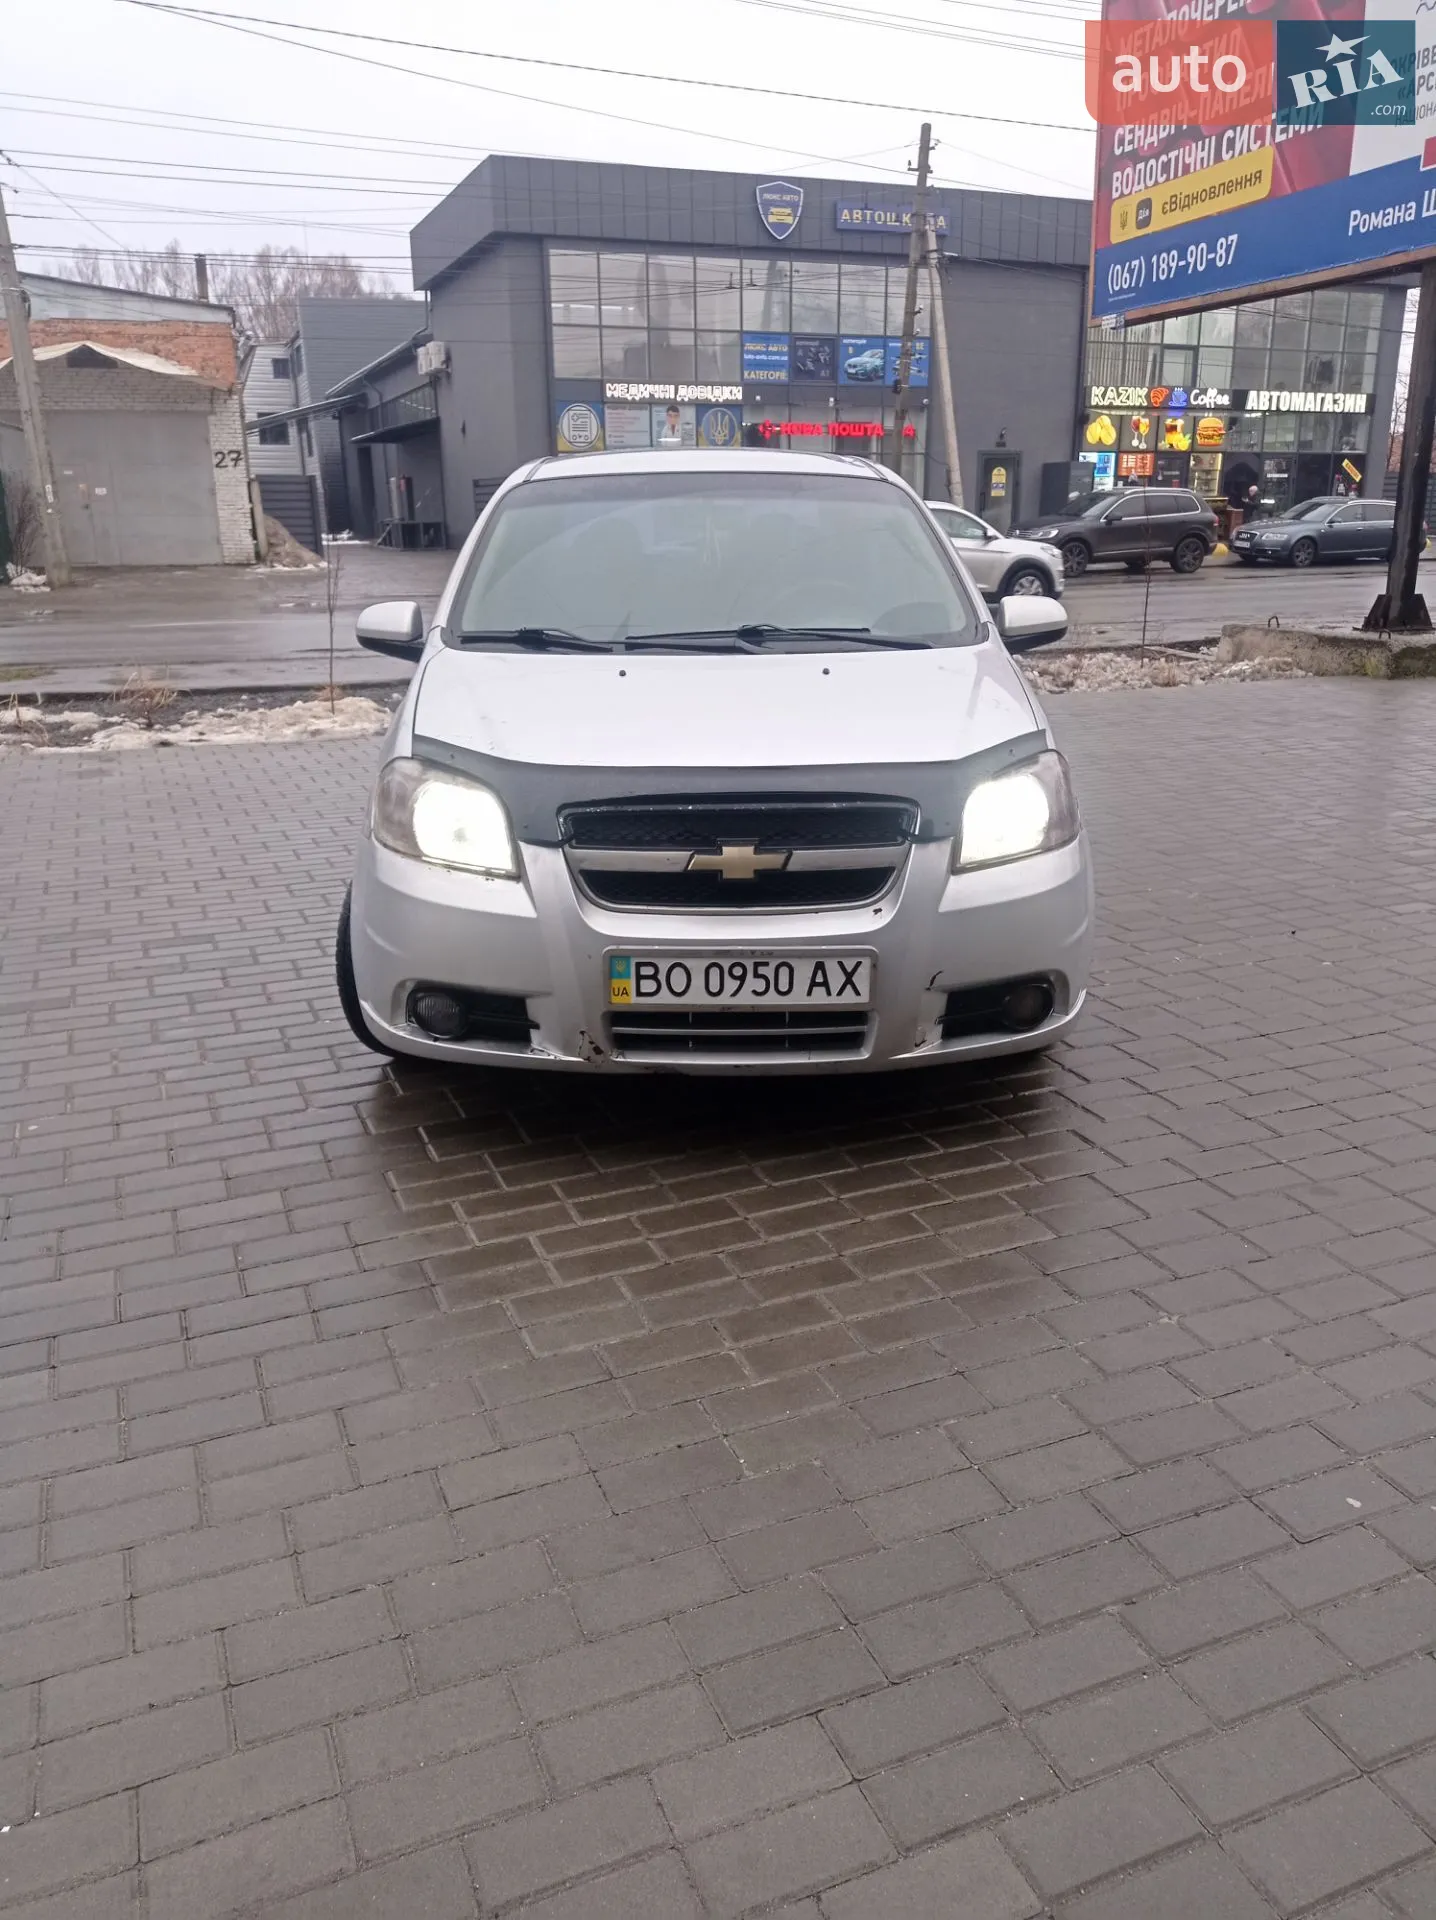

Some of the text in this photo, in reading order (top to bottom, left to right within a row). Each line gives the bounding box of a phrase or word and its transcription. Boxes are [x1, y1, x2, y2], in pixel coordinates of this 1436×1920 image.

[1111, 102, 1324, 199] ВОДОСТІЧНІ СИСТЕМИ
[1161, 169, 1263, 215] єВідновлення
[1348, 201, 1416, 236] Романа
[1107, 233, 1238, 294] (067) 189-90-87
[605, 383, 743, 402] МЕДИЧНІ ДОВІДКИ
[1090, 385, 1148, 406] KAZIK
[1189, 387, 1230, 409] Coffee
[1245, 389, 1367, 414] АВТОМАГАЗИН
[828, 423, 884, 437] ПОШТА
[214, 450, 243, 468] 27
[634, 960, 863, 998] BO 0950 AX
[611, 986, 629, 997] UA
